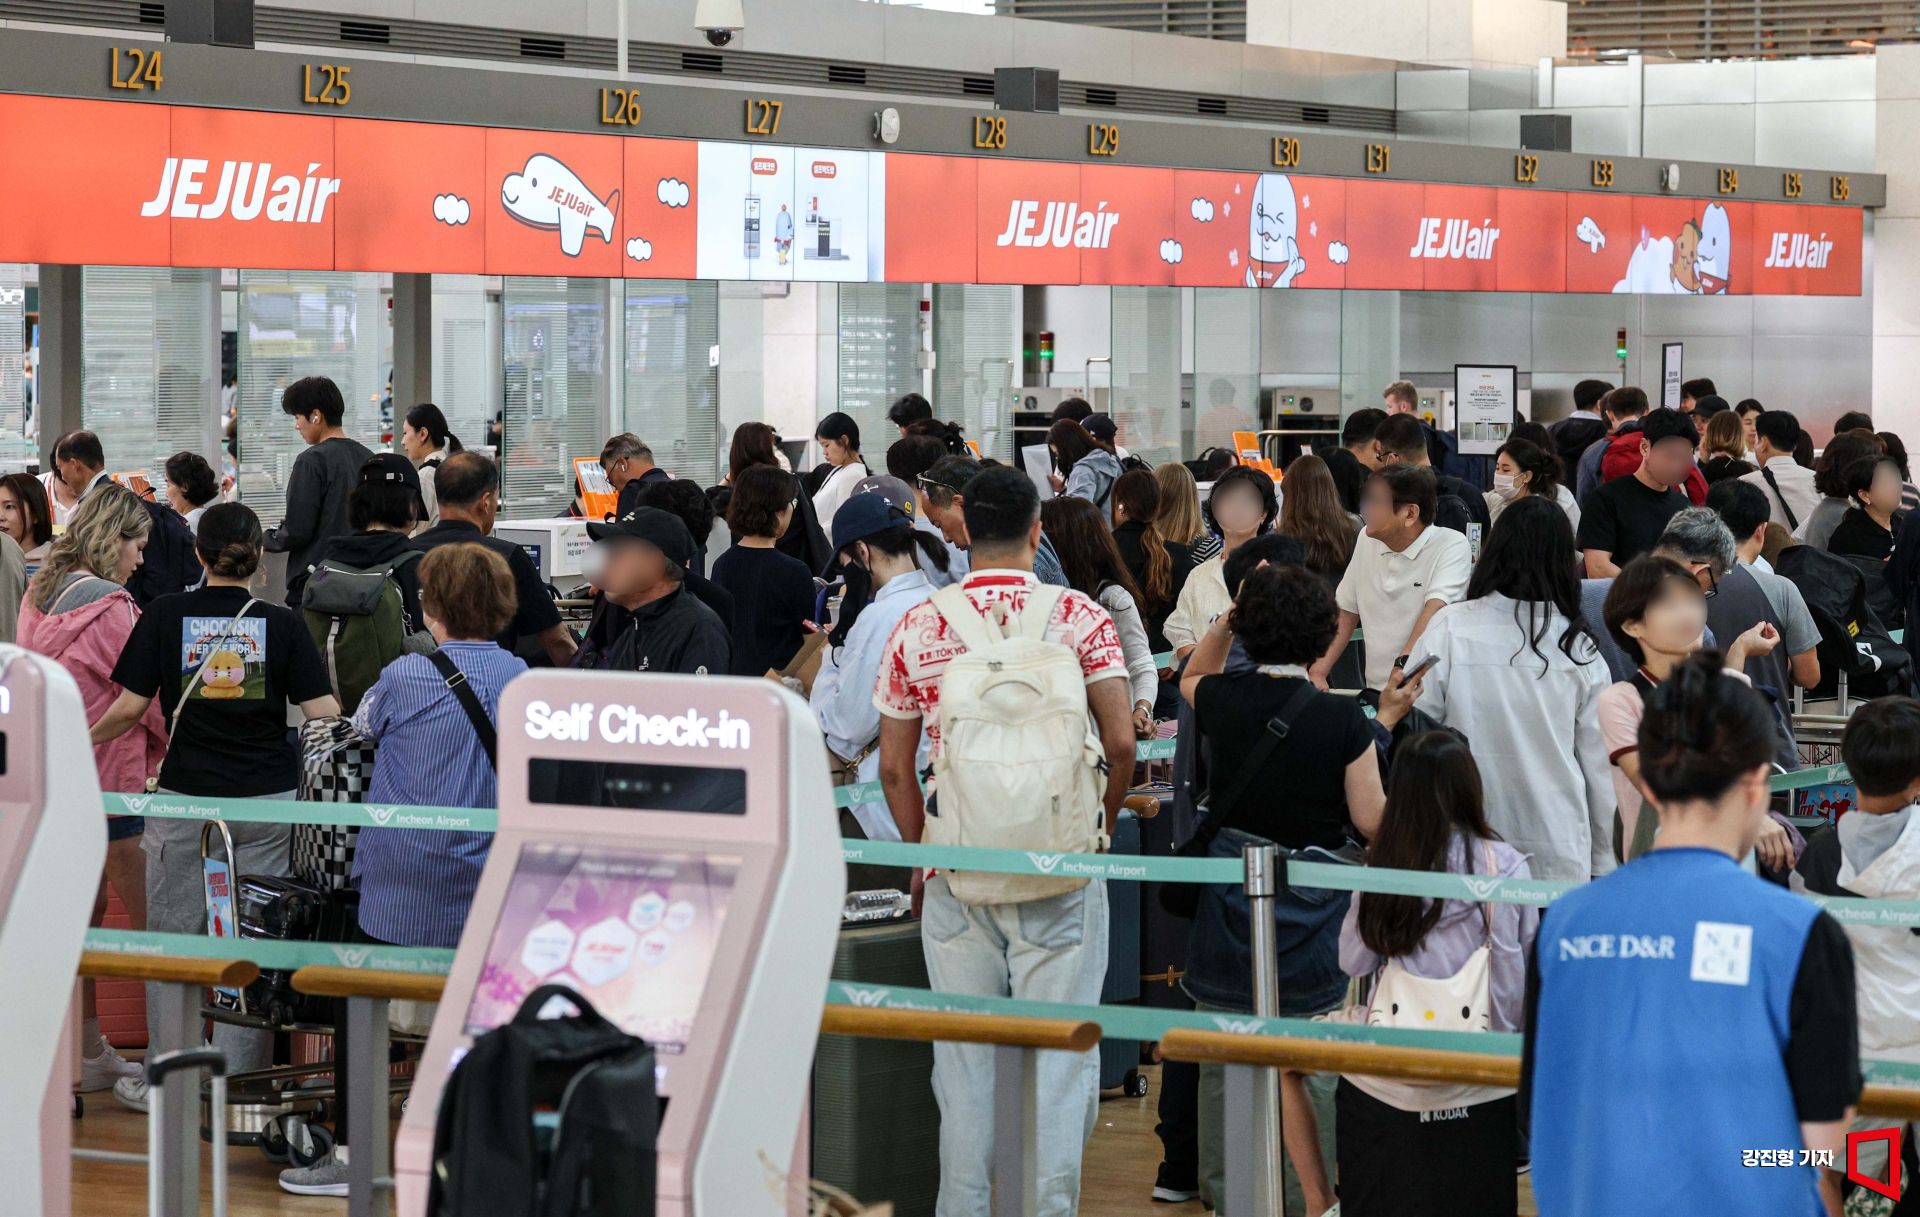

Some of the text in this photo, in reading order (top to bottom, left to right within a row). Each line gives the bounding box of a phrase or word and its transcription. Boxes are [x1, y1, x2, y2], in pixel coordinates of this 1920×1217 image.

[110, 48, 163, 91] L24
[303, 64, 351, 105] L25
[600, 88, 641, 126] L26
[746, 99, 783, 135] L27
[974, 115, 1007, 149] L28
[1089, 124, 1119, 156] L29
[1272, 137, 1300, 167] L30
[1365, 143, 1390, 172] L31
[1515, 154, 1538, 183] L32
[1593, 159, 1614, 187] L33
[1718, 168, 1738, 194] L34
[1784, 172, 1802, 197] L35
[1831, 175, 1850, 200] L36
[525, 700, 750, 749] Self Check-in
[150, 804, 220, 817] Incheon Airport
[396, 814, 470, 827] Incheon Airport
[1063, 862, 1147, 877] Incheon Airport
[1500, 887, 1547, 900] Incheon
[1559, 934, 1675, 961] NICE D&R
[1433, 1107, 1469, 1121] KODAK
